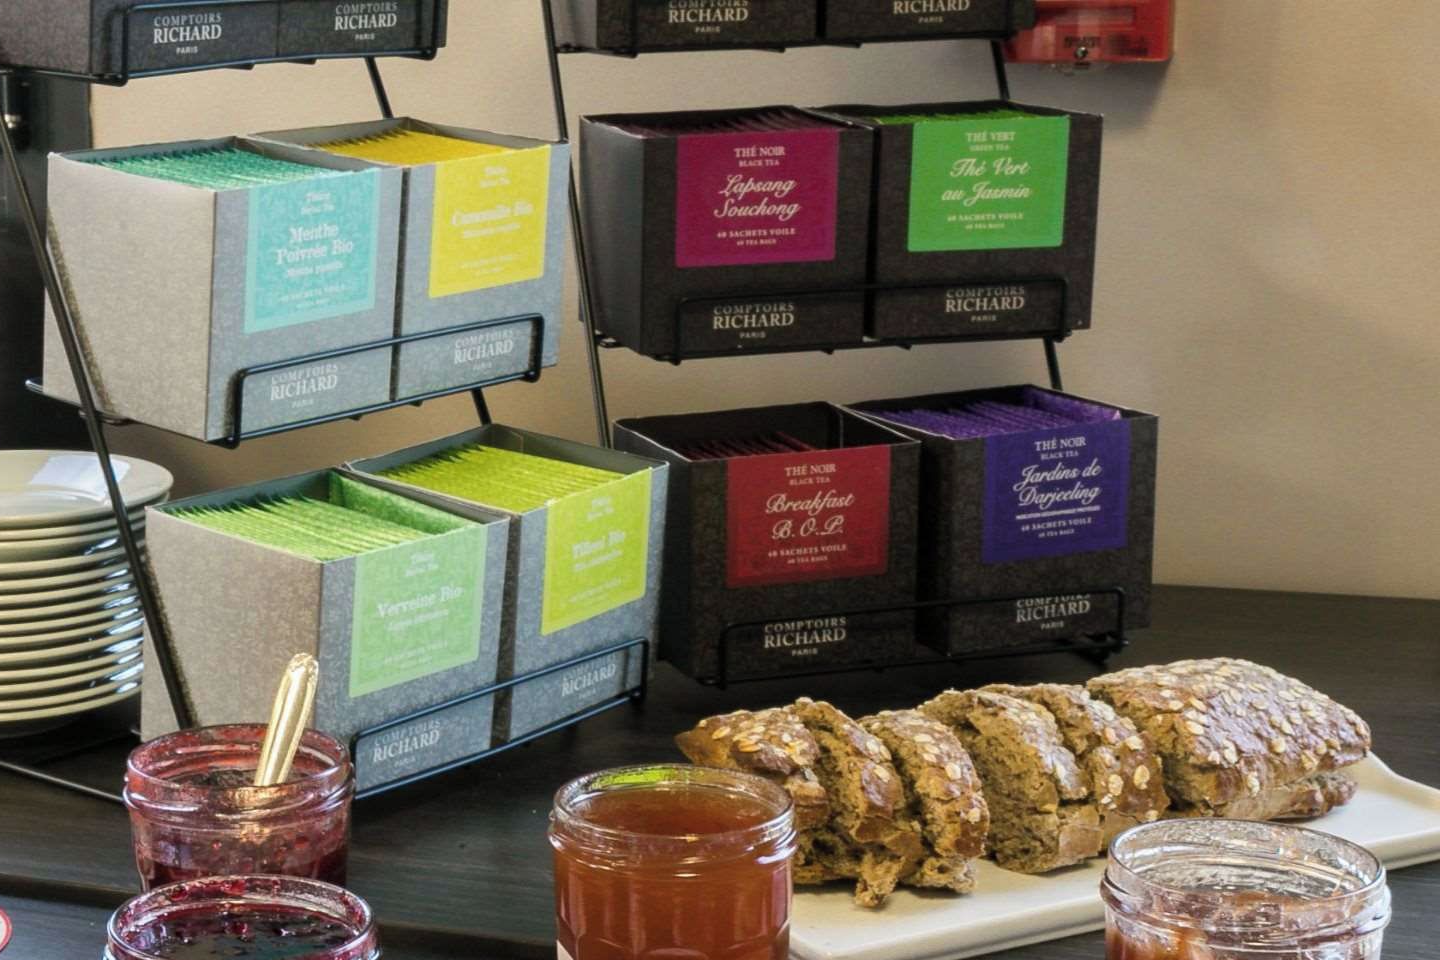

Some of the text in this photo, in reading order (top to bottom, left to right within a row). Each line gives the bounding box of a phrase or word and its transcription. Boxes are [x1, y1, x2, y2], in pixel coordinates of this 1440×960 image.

[335, 2, 397, 16] COMPTOIRS
[668, 8, 749, 23] RICHARD
[893, 0, 970, 14] RICHARD
[154, 12, 222, 27] COMPTOIRS
[334, 12, 397, 31] RICHARD
[153, 24, 222, 44] RICHARD
[991, 132, 1016, 142] VERT
[734, 145, 785, 158] THÉ NOIR
[739, 159, 762, 167] BLACK
[950, 157, 1030, 177] Thé Vert
[718, 174, 796, 200] Lapsang
[942, 181, 1031, 207] au Jasmin
[714, 197, 802, 222] Souchong
[289, 224, 339, 243] Menthe
[331, 239, 354, 255] Bio
[946, 285, 1024, 298] COMPTOIRS
[714, 302, 795, 315] COMPTOIRS
[945, 296, 1025, 312] RICHARD
[713, 312, 795, 329] RICHARD
[453, 339, 513, 365] RICHARD
[271, 373, 338, 400] RICHARD
[1034, 436, 1086, 452] THÉ NOIR
[784, 463, 836, 477] THÉ NOIR
[1013, 457, 1102, 492] Jardins de
[765, 489, 855, 516] Breakfast
[1018, 481, 1101, 510] Darjeeling
[1016, 600, 1091, 624] RICHARD
[764, 616, 847, 634] COMPTOIRS
[764, 627, 847, 649] RICHARD
[560, 664, 616, 697] RICHARD
[372, 729, 440, 763] RICHARD
